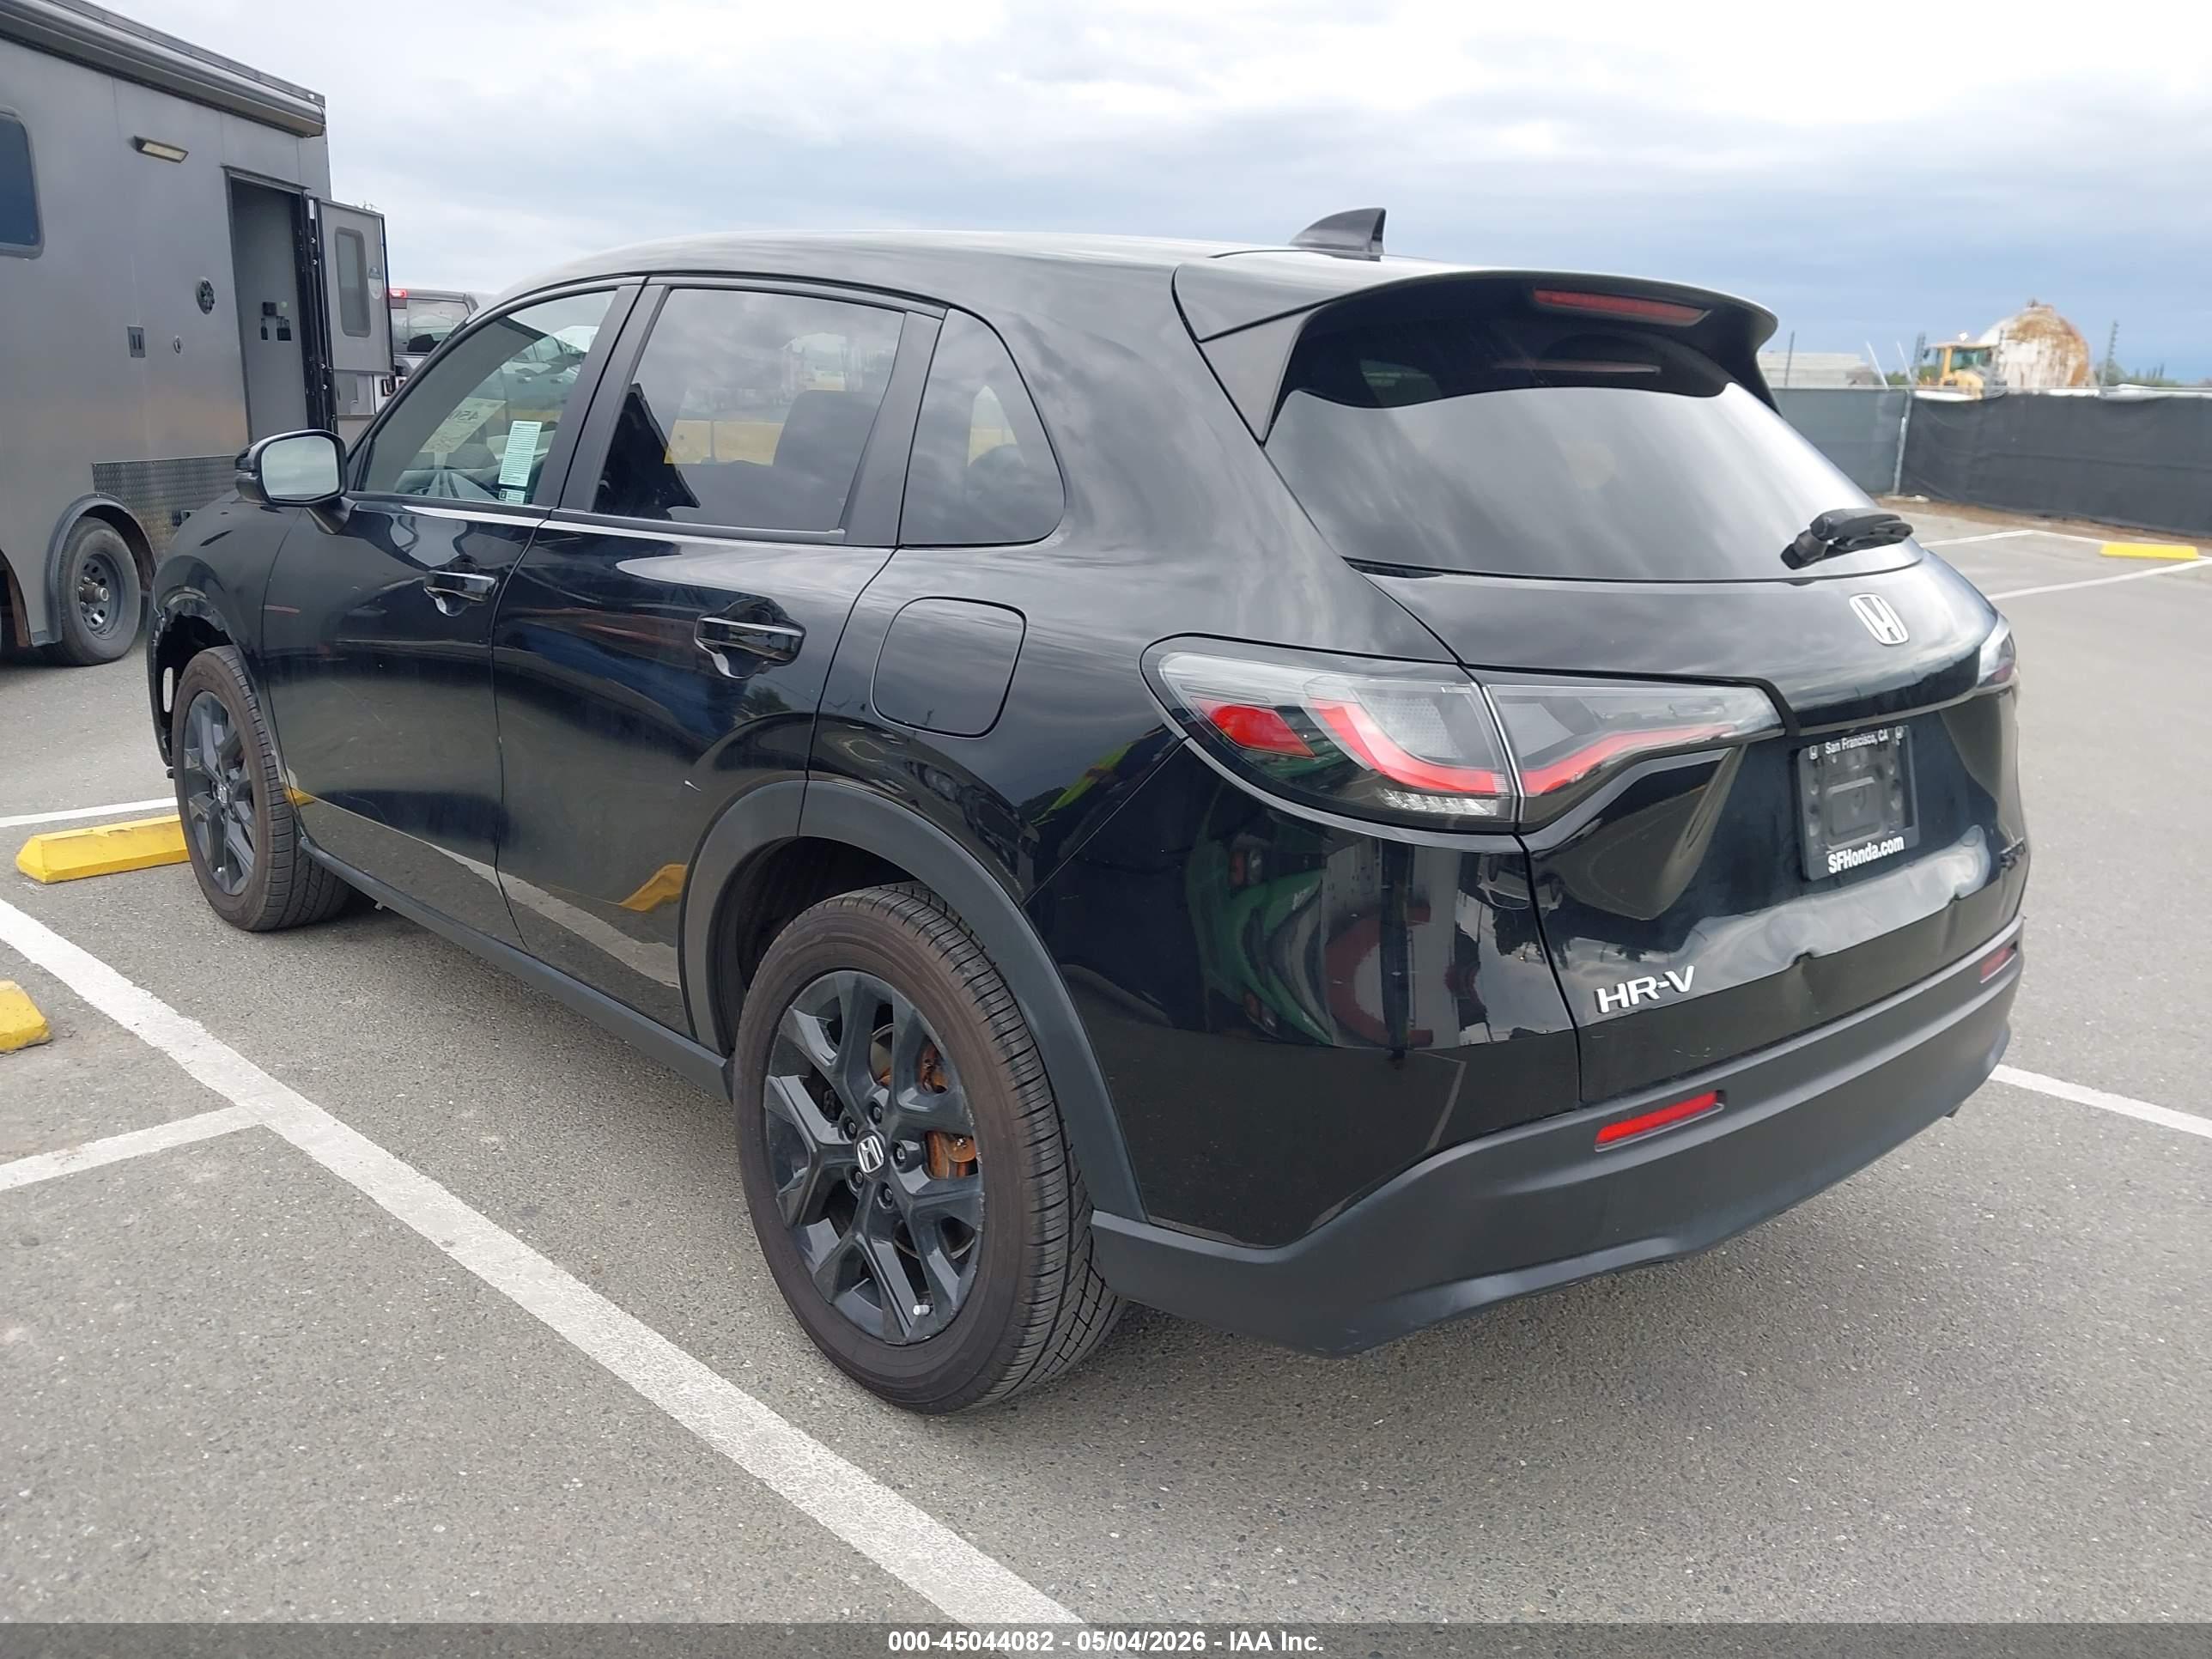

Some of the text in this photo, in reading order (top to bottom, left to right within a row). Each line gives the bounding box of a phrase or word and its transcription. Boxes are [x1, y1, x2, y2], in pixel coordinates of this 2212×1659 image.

[1825, 742, 1841, 755] San
[1841, 734, 1878, 750] Francisco,
[1878, 729, 1888, 742] CA
[1828, 836, 1905, 873] SFHonda.com
[1595, 964, 1695, 1014] HR-V
